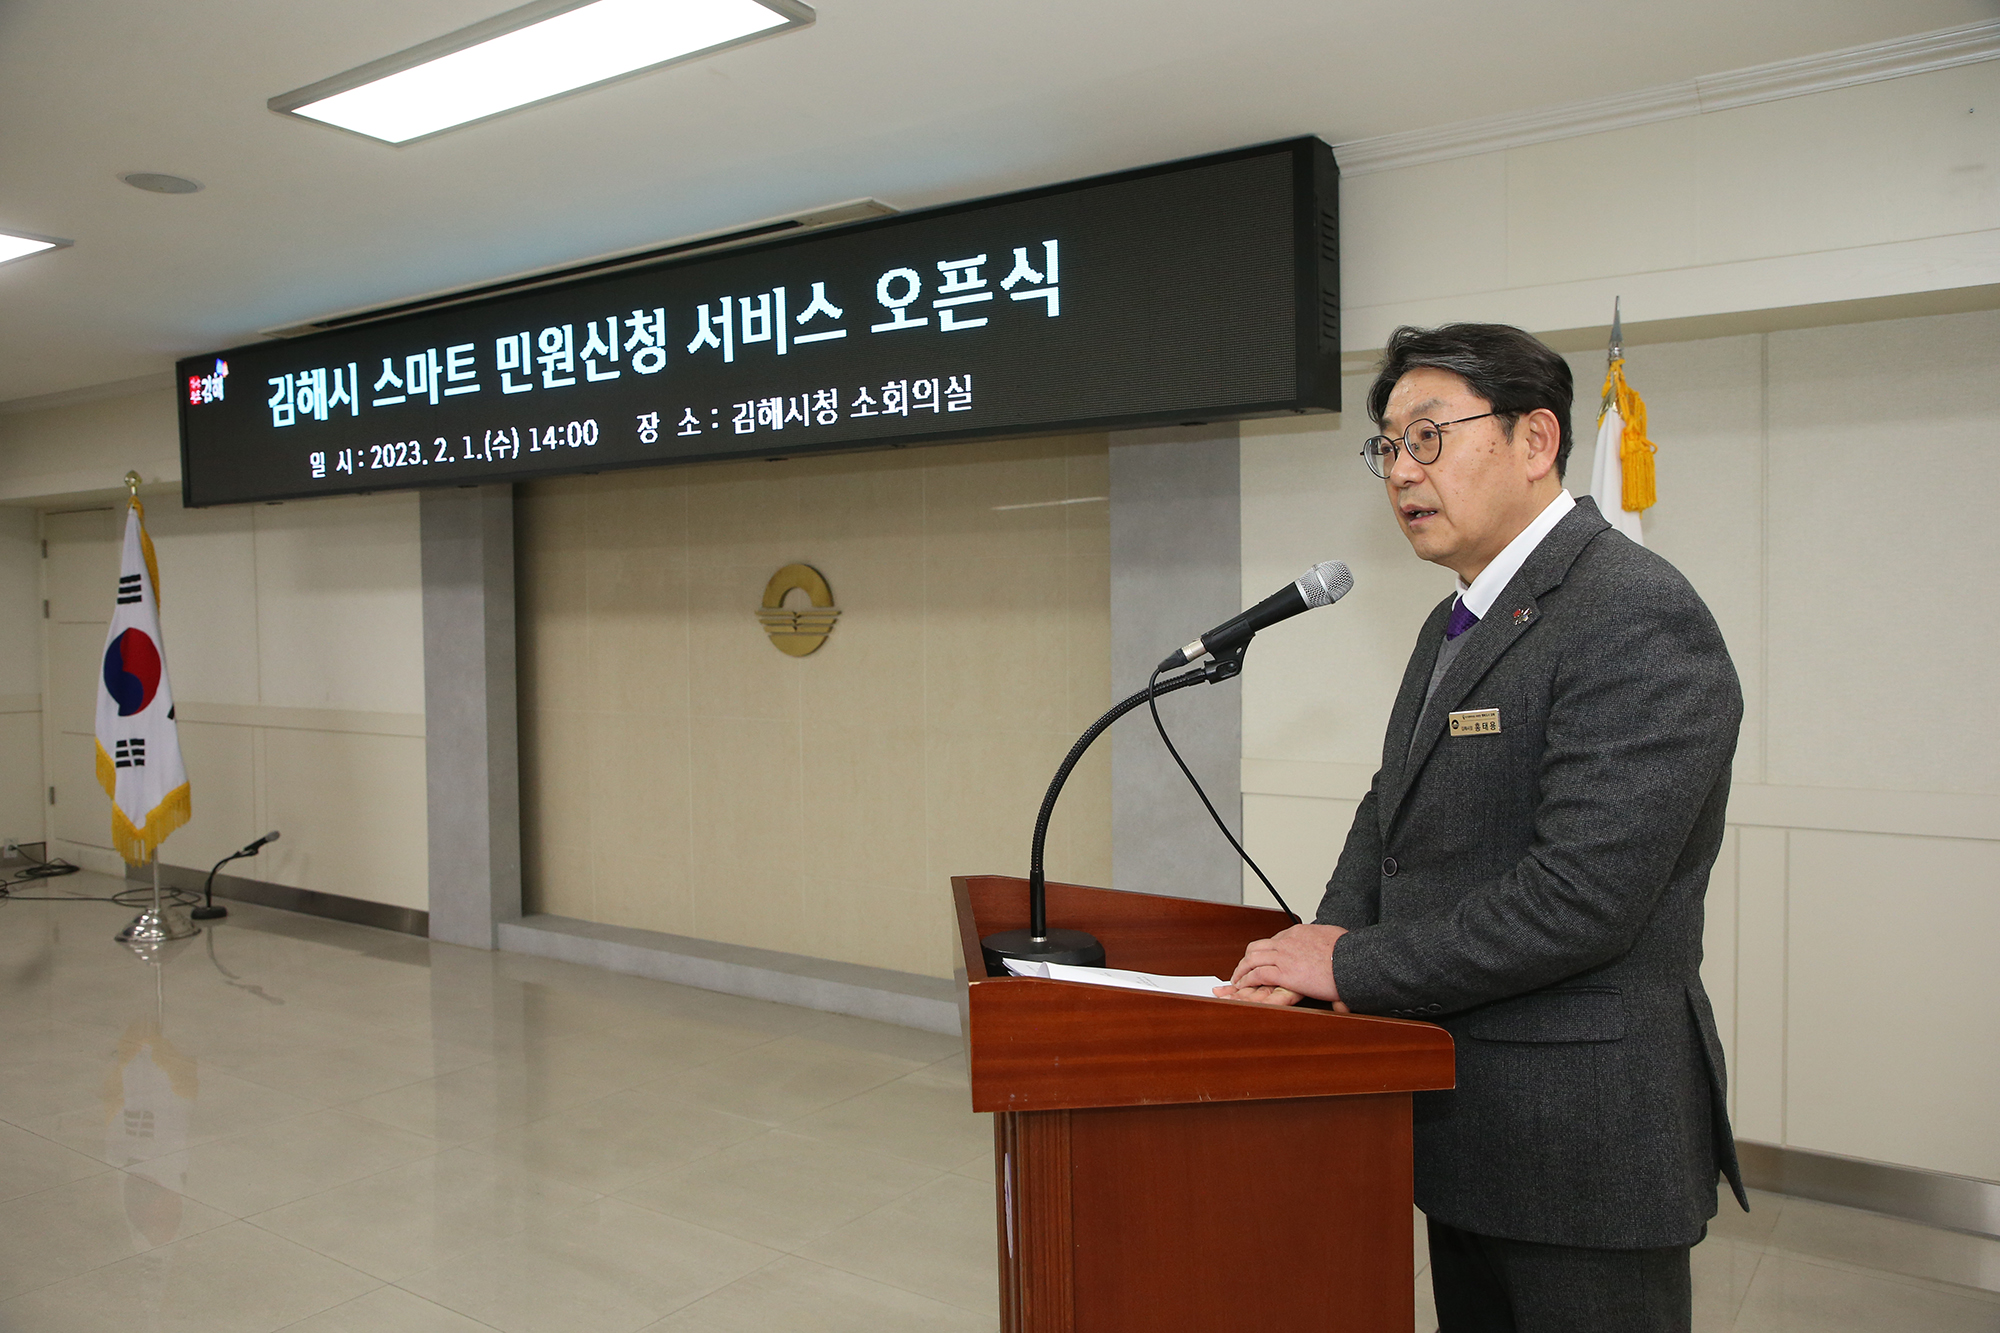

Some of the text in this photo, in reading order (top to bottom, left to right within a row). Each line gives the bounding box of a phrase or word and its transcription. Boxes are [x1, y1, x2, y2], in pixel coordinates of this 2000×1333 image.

[267, 239, 1060, 428] 김해시 스마트 민원신청 서비스 오픈식
[731, 387, 839, 435] 김해시청
[849, 373, 973, 418] 소회의실
[370, 440, 429, 470] 2023.
[433, 437, 455, 463] 2.
[529, 418, 599, 453] 14:00
